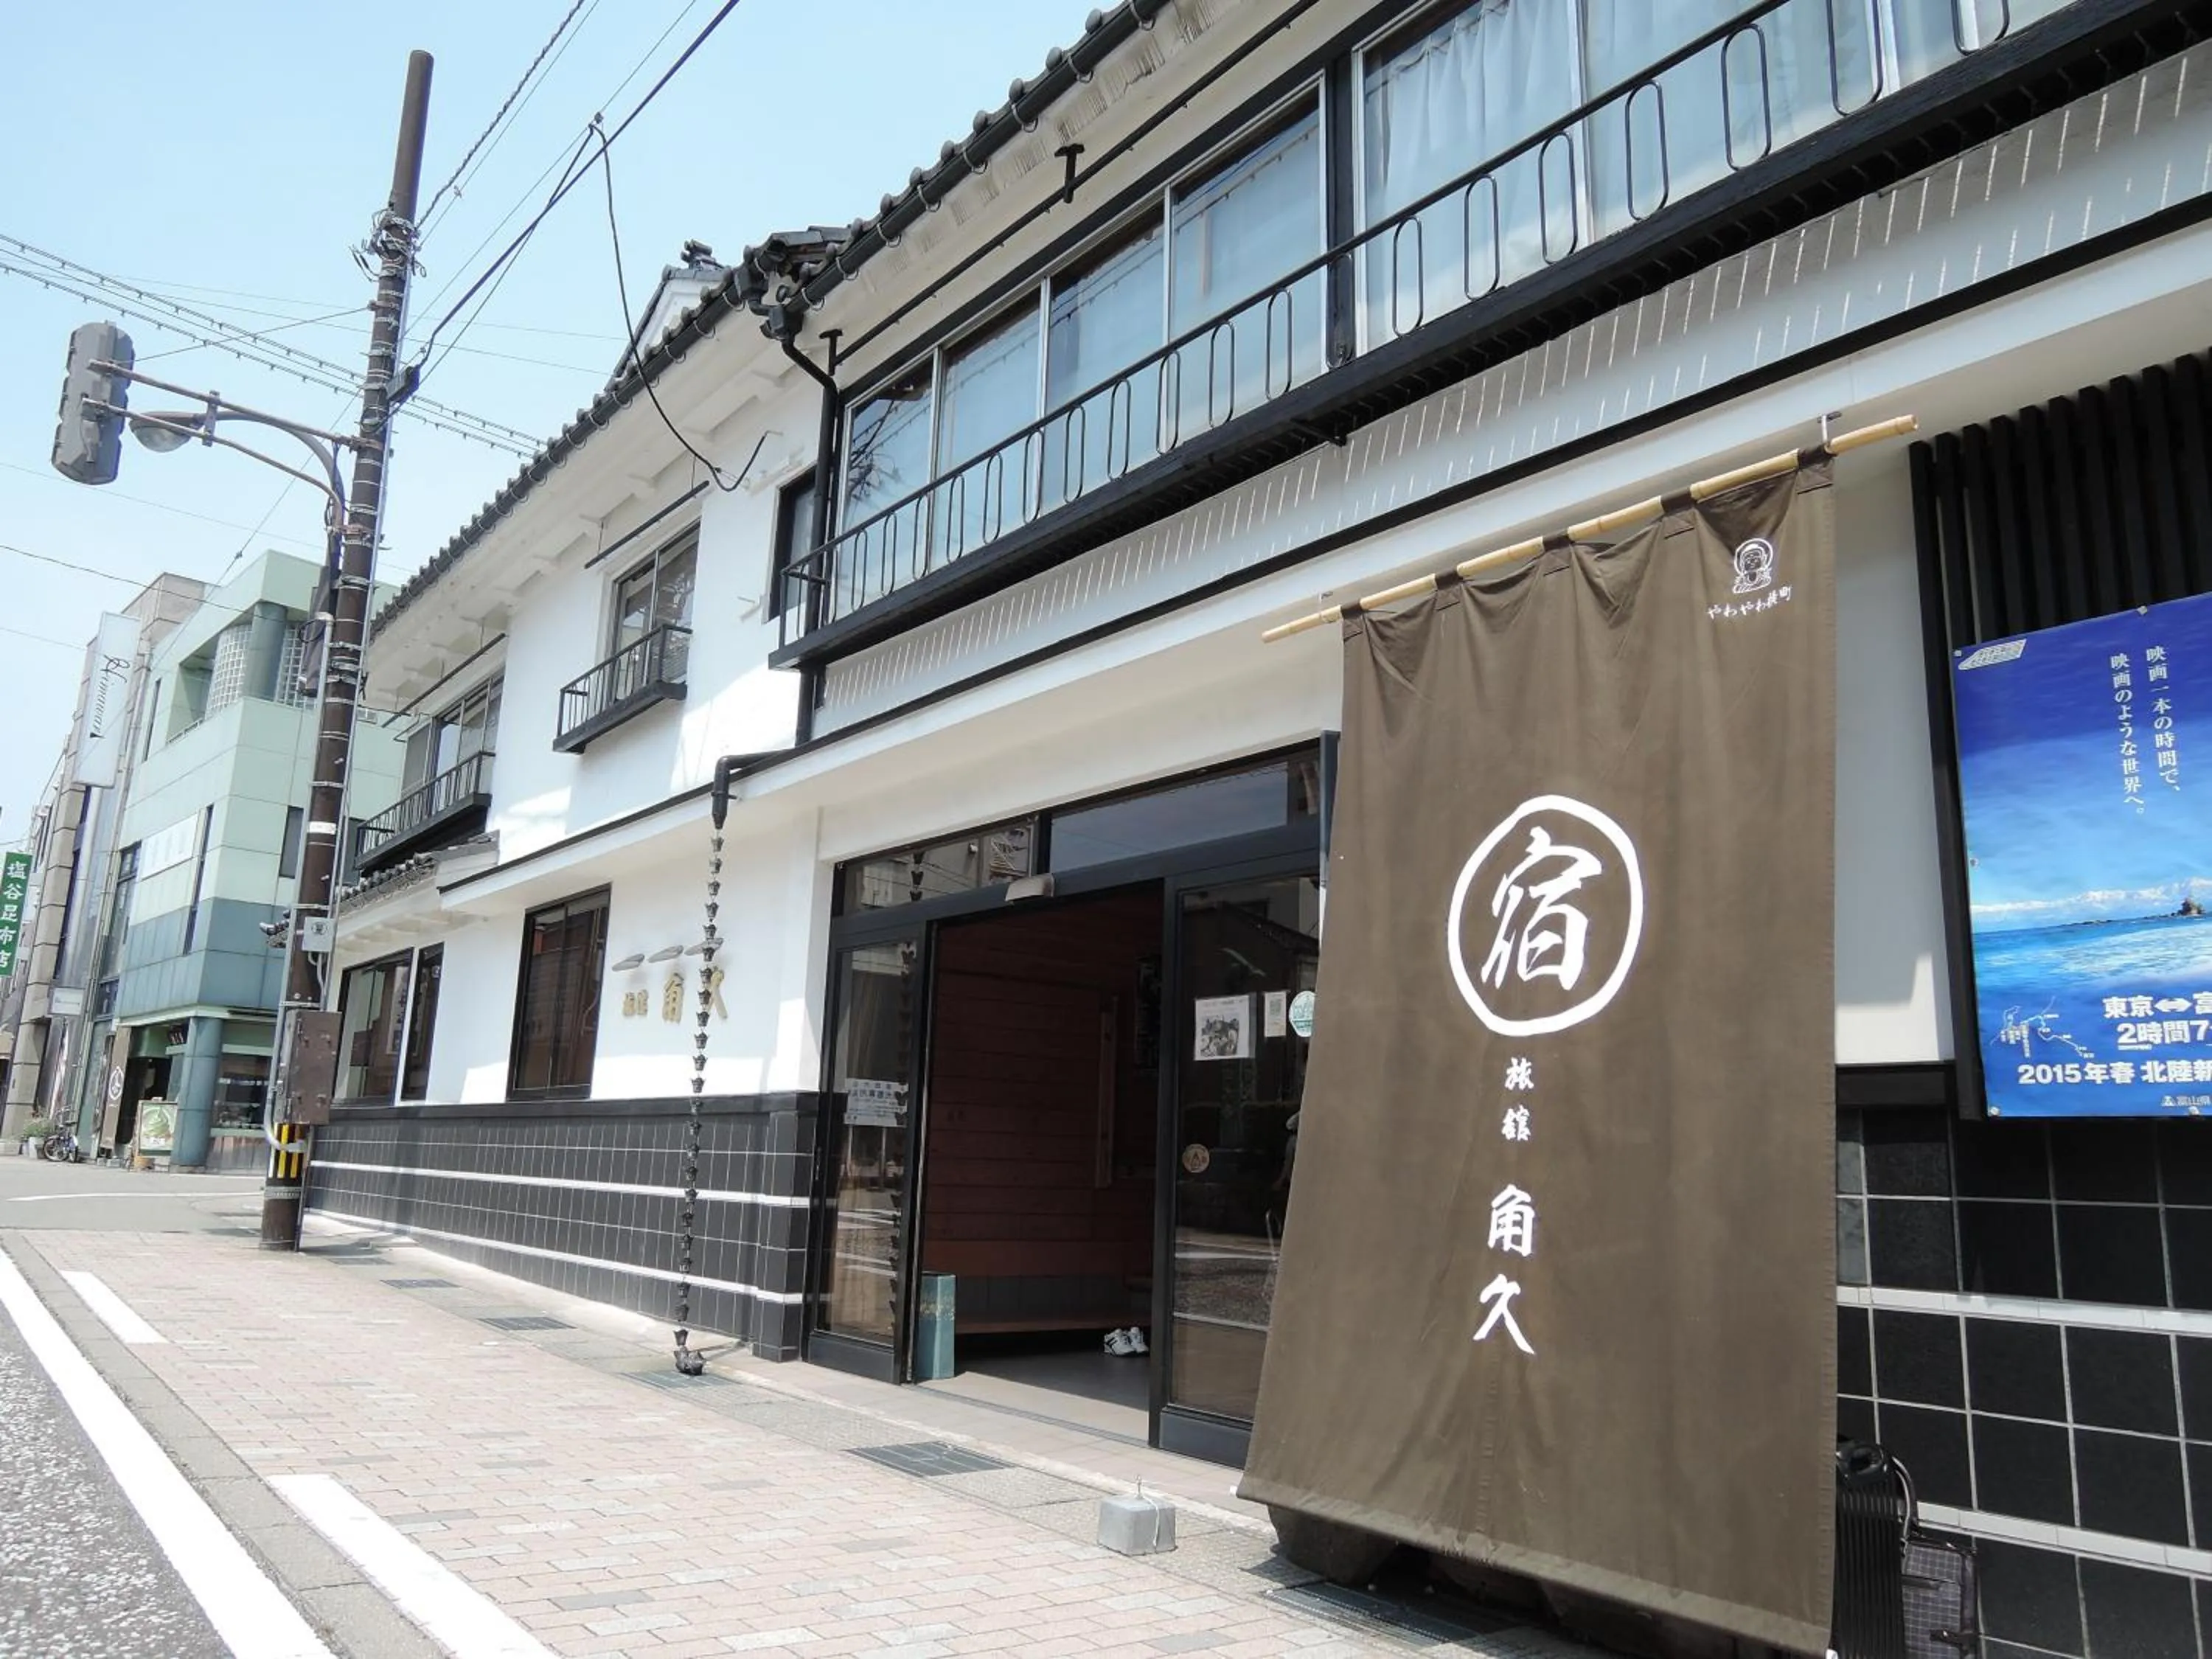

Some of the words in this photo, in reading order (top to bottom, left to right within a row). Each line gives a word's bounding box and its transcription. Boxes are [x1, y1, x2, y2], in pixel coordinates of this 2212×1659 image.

[2110, 653, 2144, 814] 映画のような世界へ。
[2146, 645, 2180, 791] 映画一本の時間で、
[1481, 826, 1602, 990] 宿
[2017, 1061, 2135, 1085] 2015年春
[2117, 1020, 2212, 1045] 2時間7
[1473, 1184, 1535, 1354] 角久
